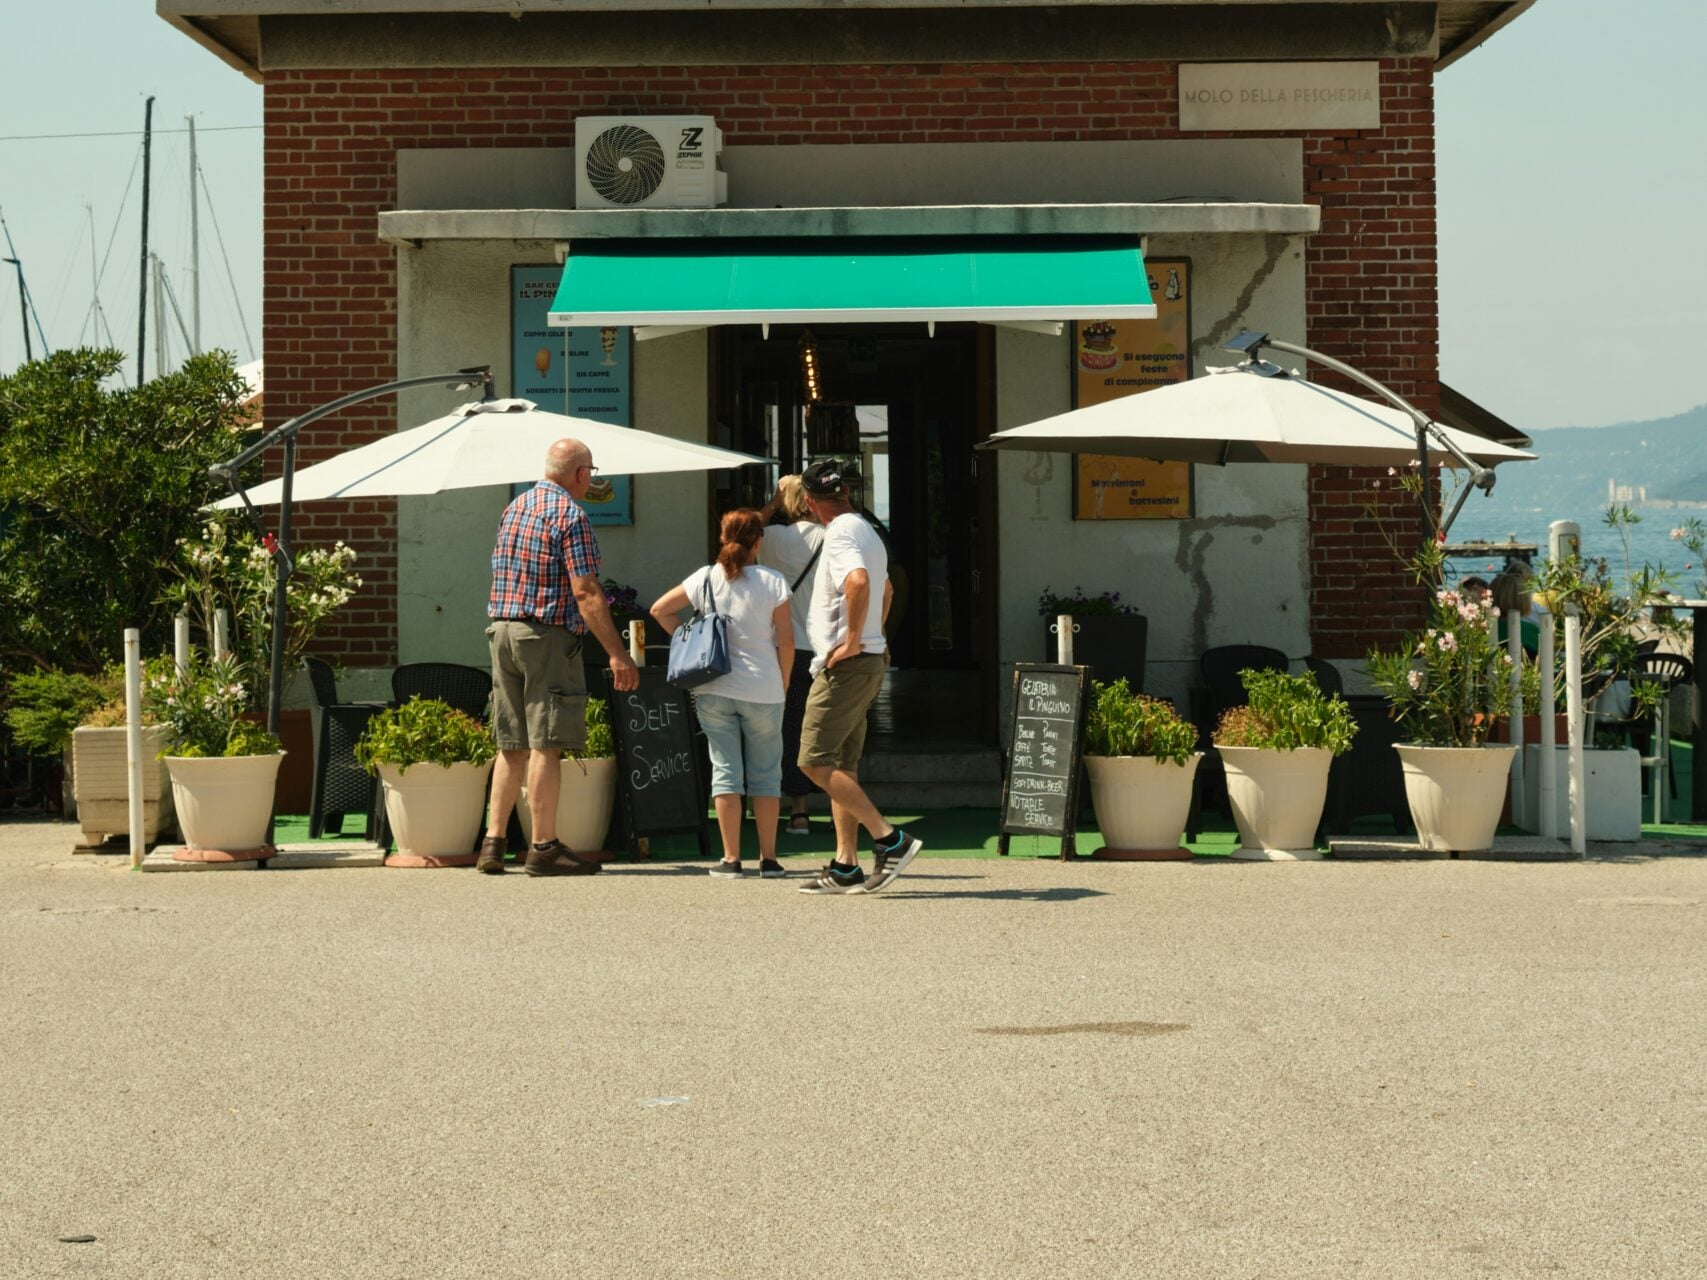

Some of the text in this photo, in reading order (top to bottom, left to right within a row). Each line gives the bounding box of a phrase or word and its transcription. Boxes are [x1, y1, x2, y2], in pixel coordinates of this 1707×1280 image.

[1185, 87, 1373, 104] MOLO DELLA PESCHERIA
[1104, 377, 1114, 386] di
[1091, 479, 1145, 488] Mrimoni
[1022, 678, 1056, 697] GELATERIA
[628, 695, 680, 732] SELF
[1036, 696, 1070, 714] PINGUINO
[1024, 812, 1053, 827] SERVICE
